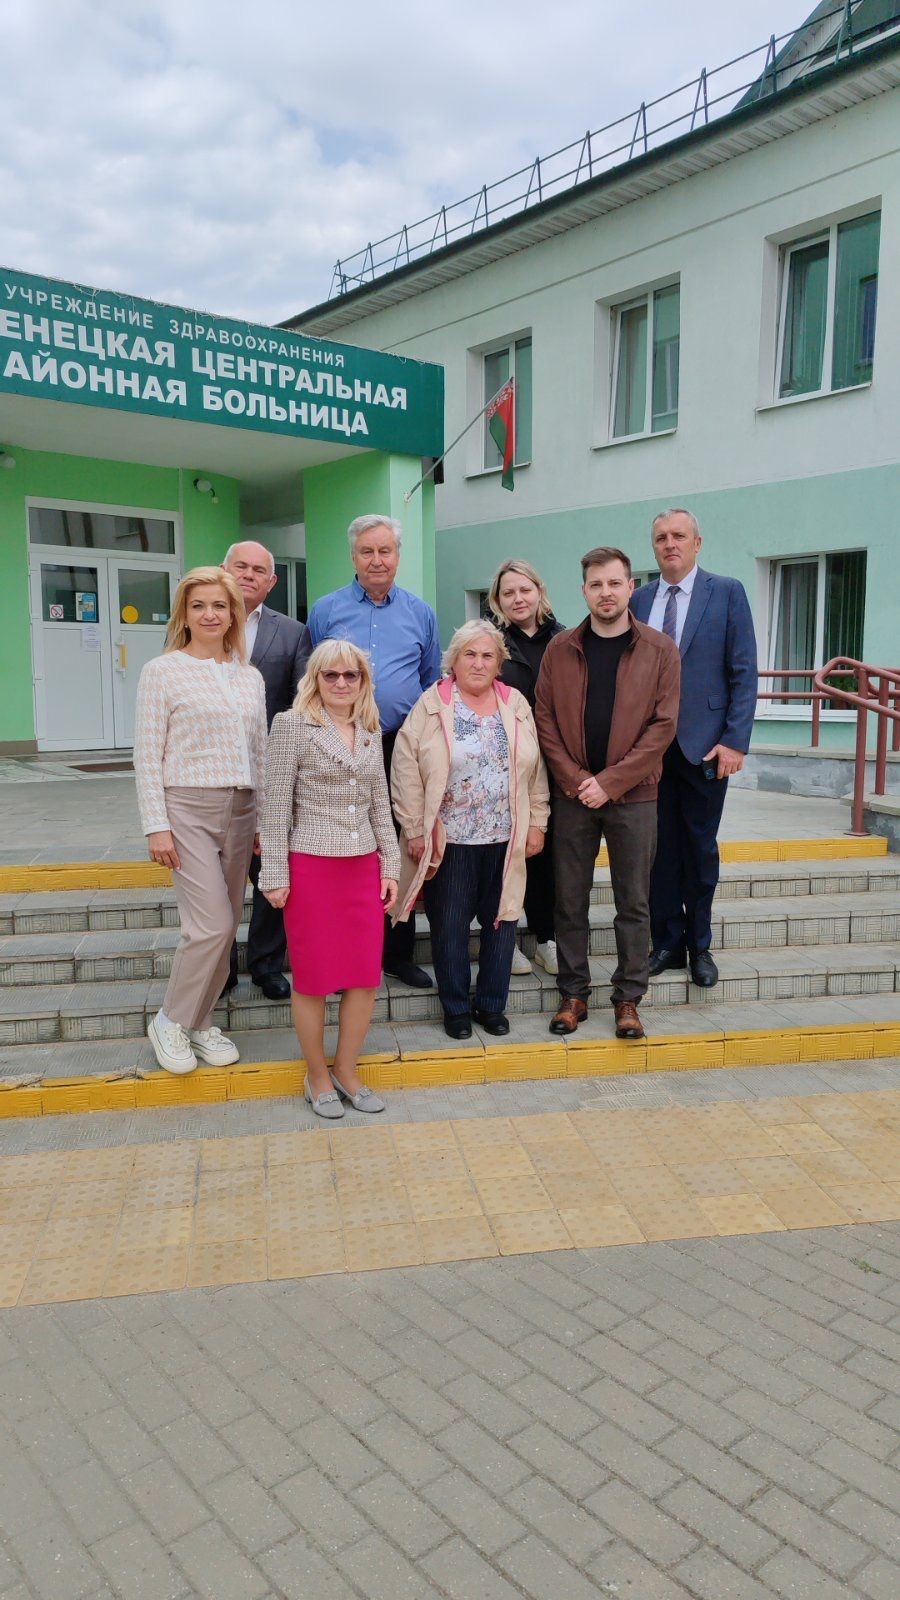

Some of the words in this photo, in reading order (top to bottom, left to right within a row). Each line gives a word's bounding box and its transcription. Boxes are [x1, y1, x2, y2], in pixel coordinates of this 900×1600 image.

[0, 309, 176, 368] ЕНЕЦКАЯ
[192, 349, 408, 410] ЦЕНТРАЛЬНАЯ
[5, 283, 154, 329] УЧРЕЖДЕНИЕ
[169, 319, 345, 368] ЗДРАВООХРАНЕНИЯ
[3, 350, 187, 406] АЙОННАЯ
[203, 386, 369, 436] БОЛЬНИЦА
